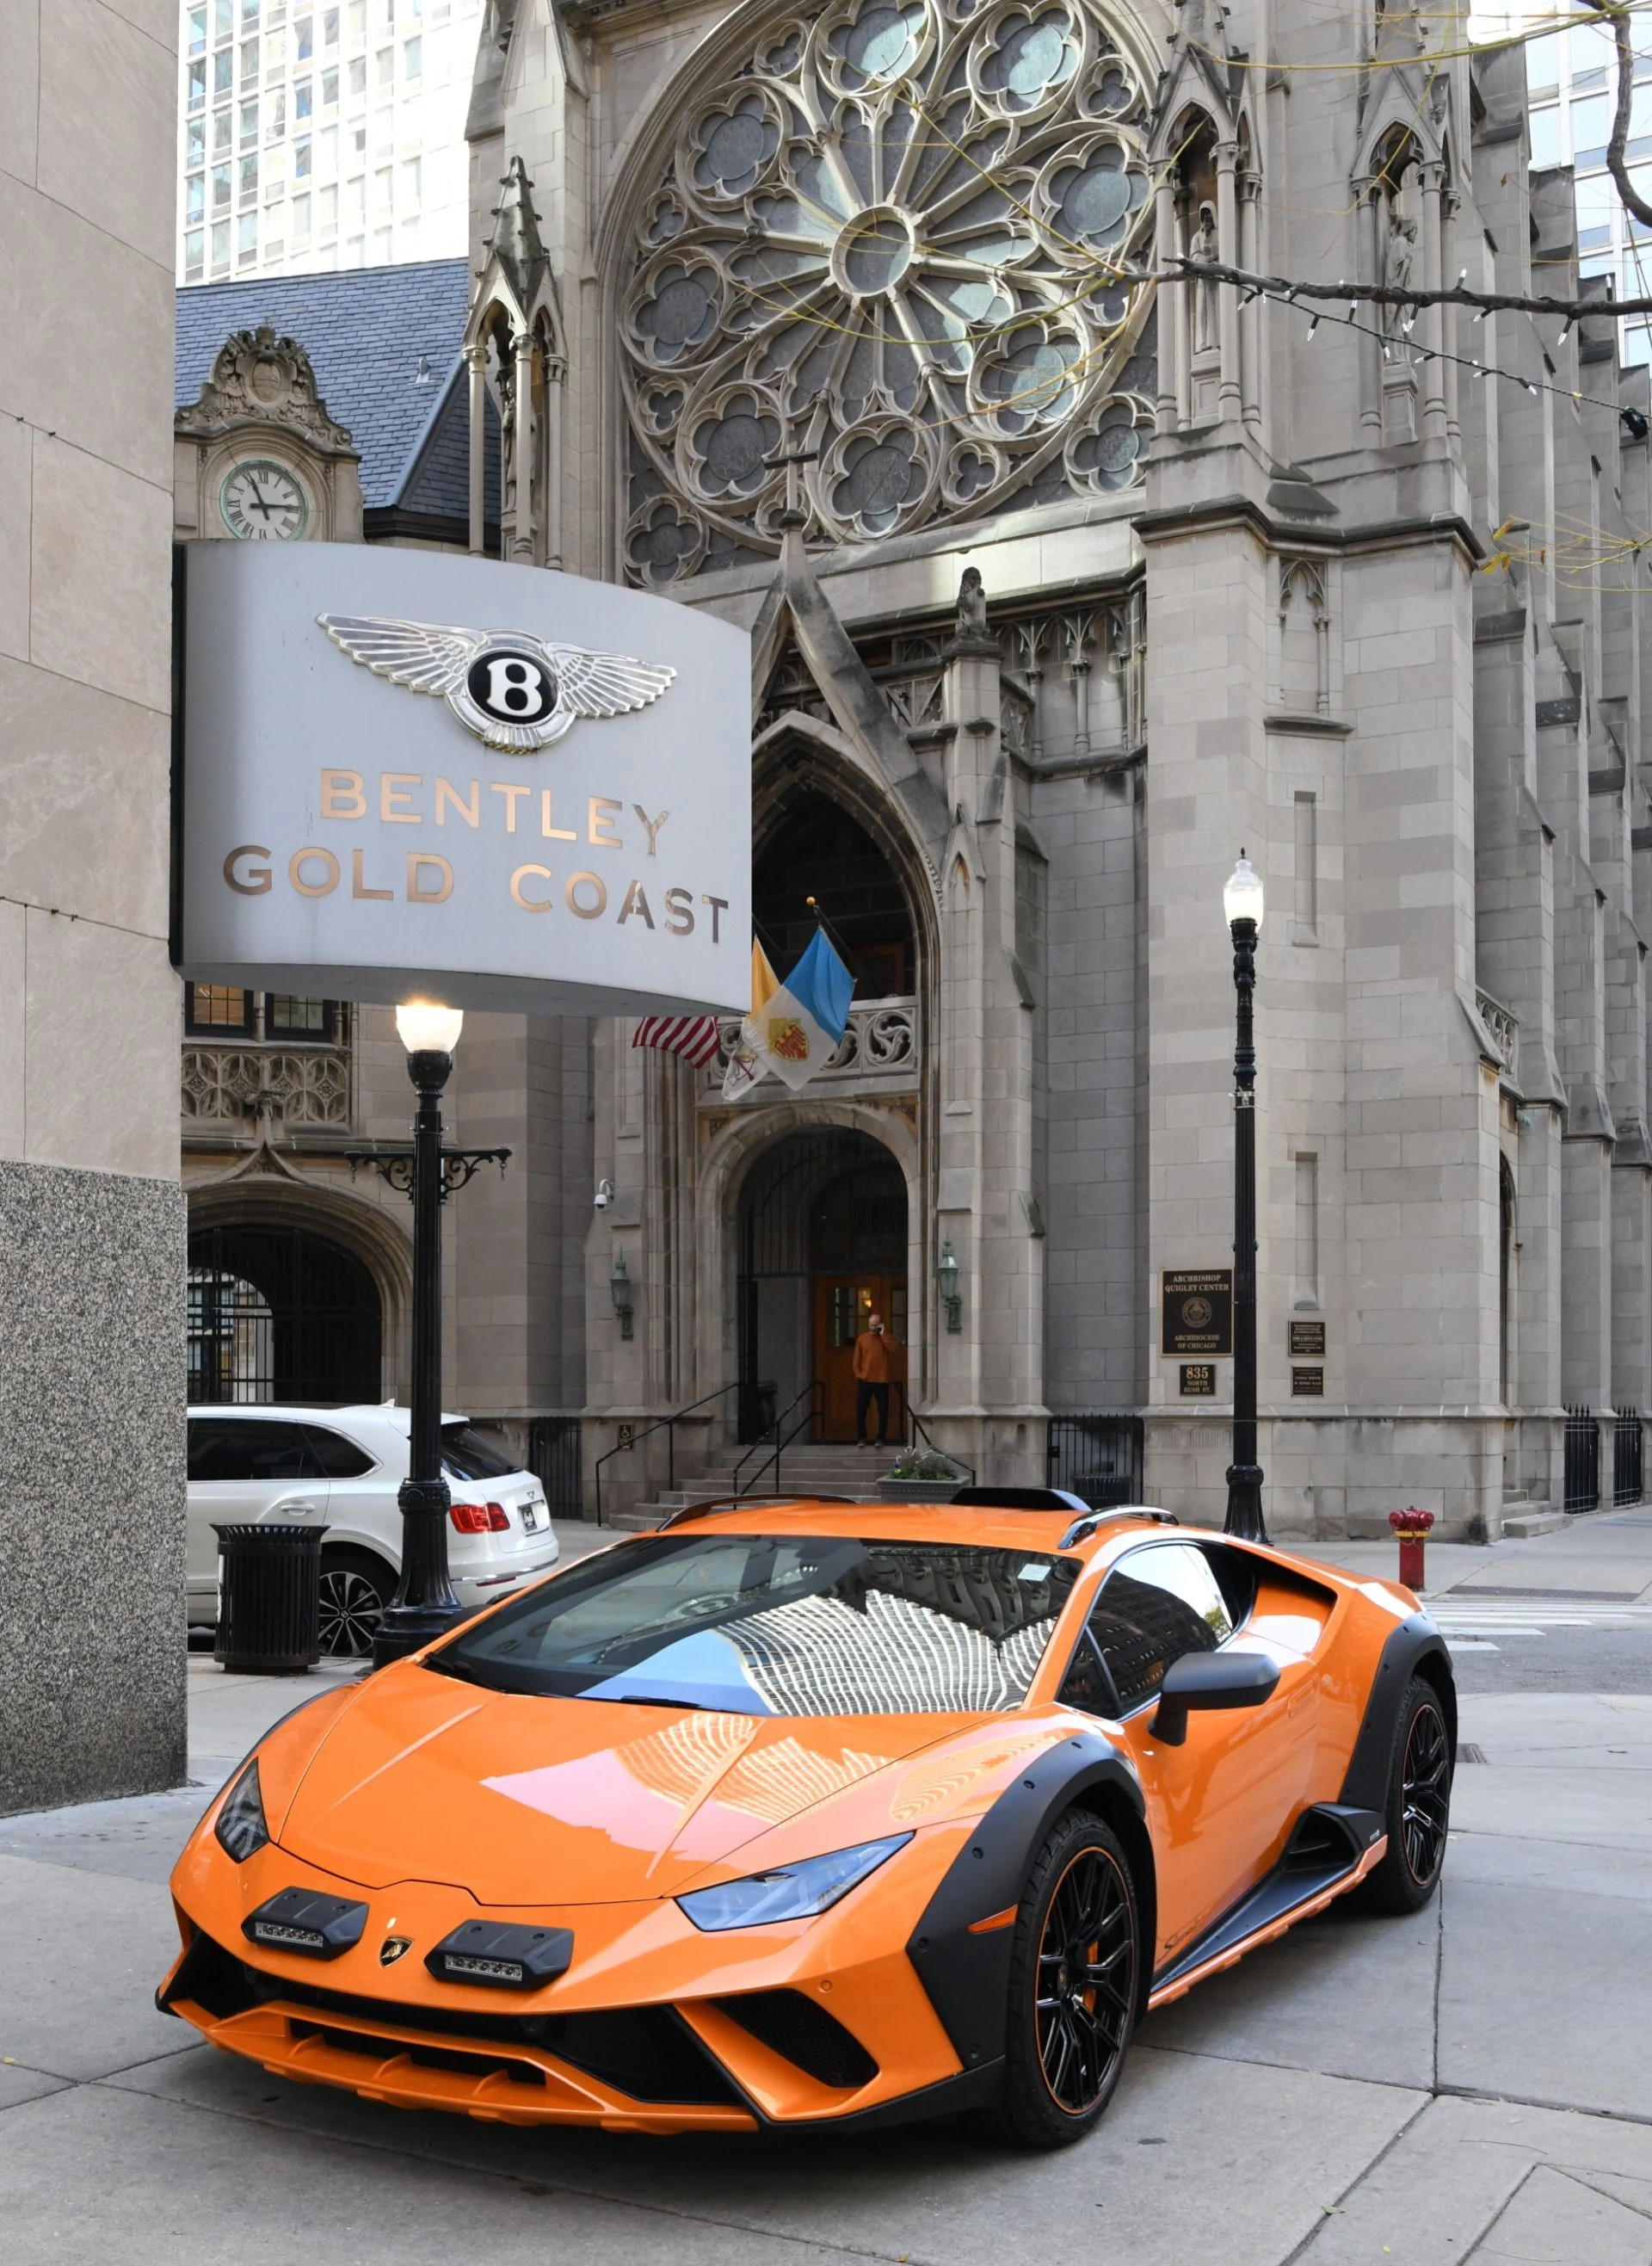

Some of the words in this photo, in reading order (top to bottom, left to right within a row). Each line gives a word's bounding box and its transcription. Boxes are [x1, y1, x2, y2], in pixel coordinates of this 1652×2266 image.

[486, 658, 542, 717] B
[320, 768, 671, 856] BENTLEY
[223, 844, 454, 903] GOLD
[509, 863, 729, 944] COAST
[1164, 1284, 1198, 1294] QUIGLEY
[1186, 1367, 1209, 1380] 835
